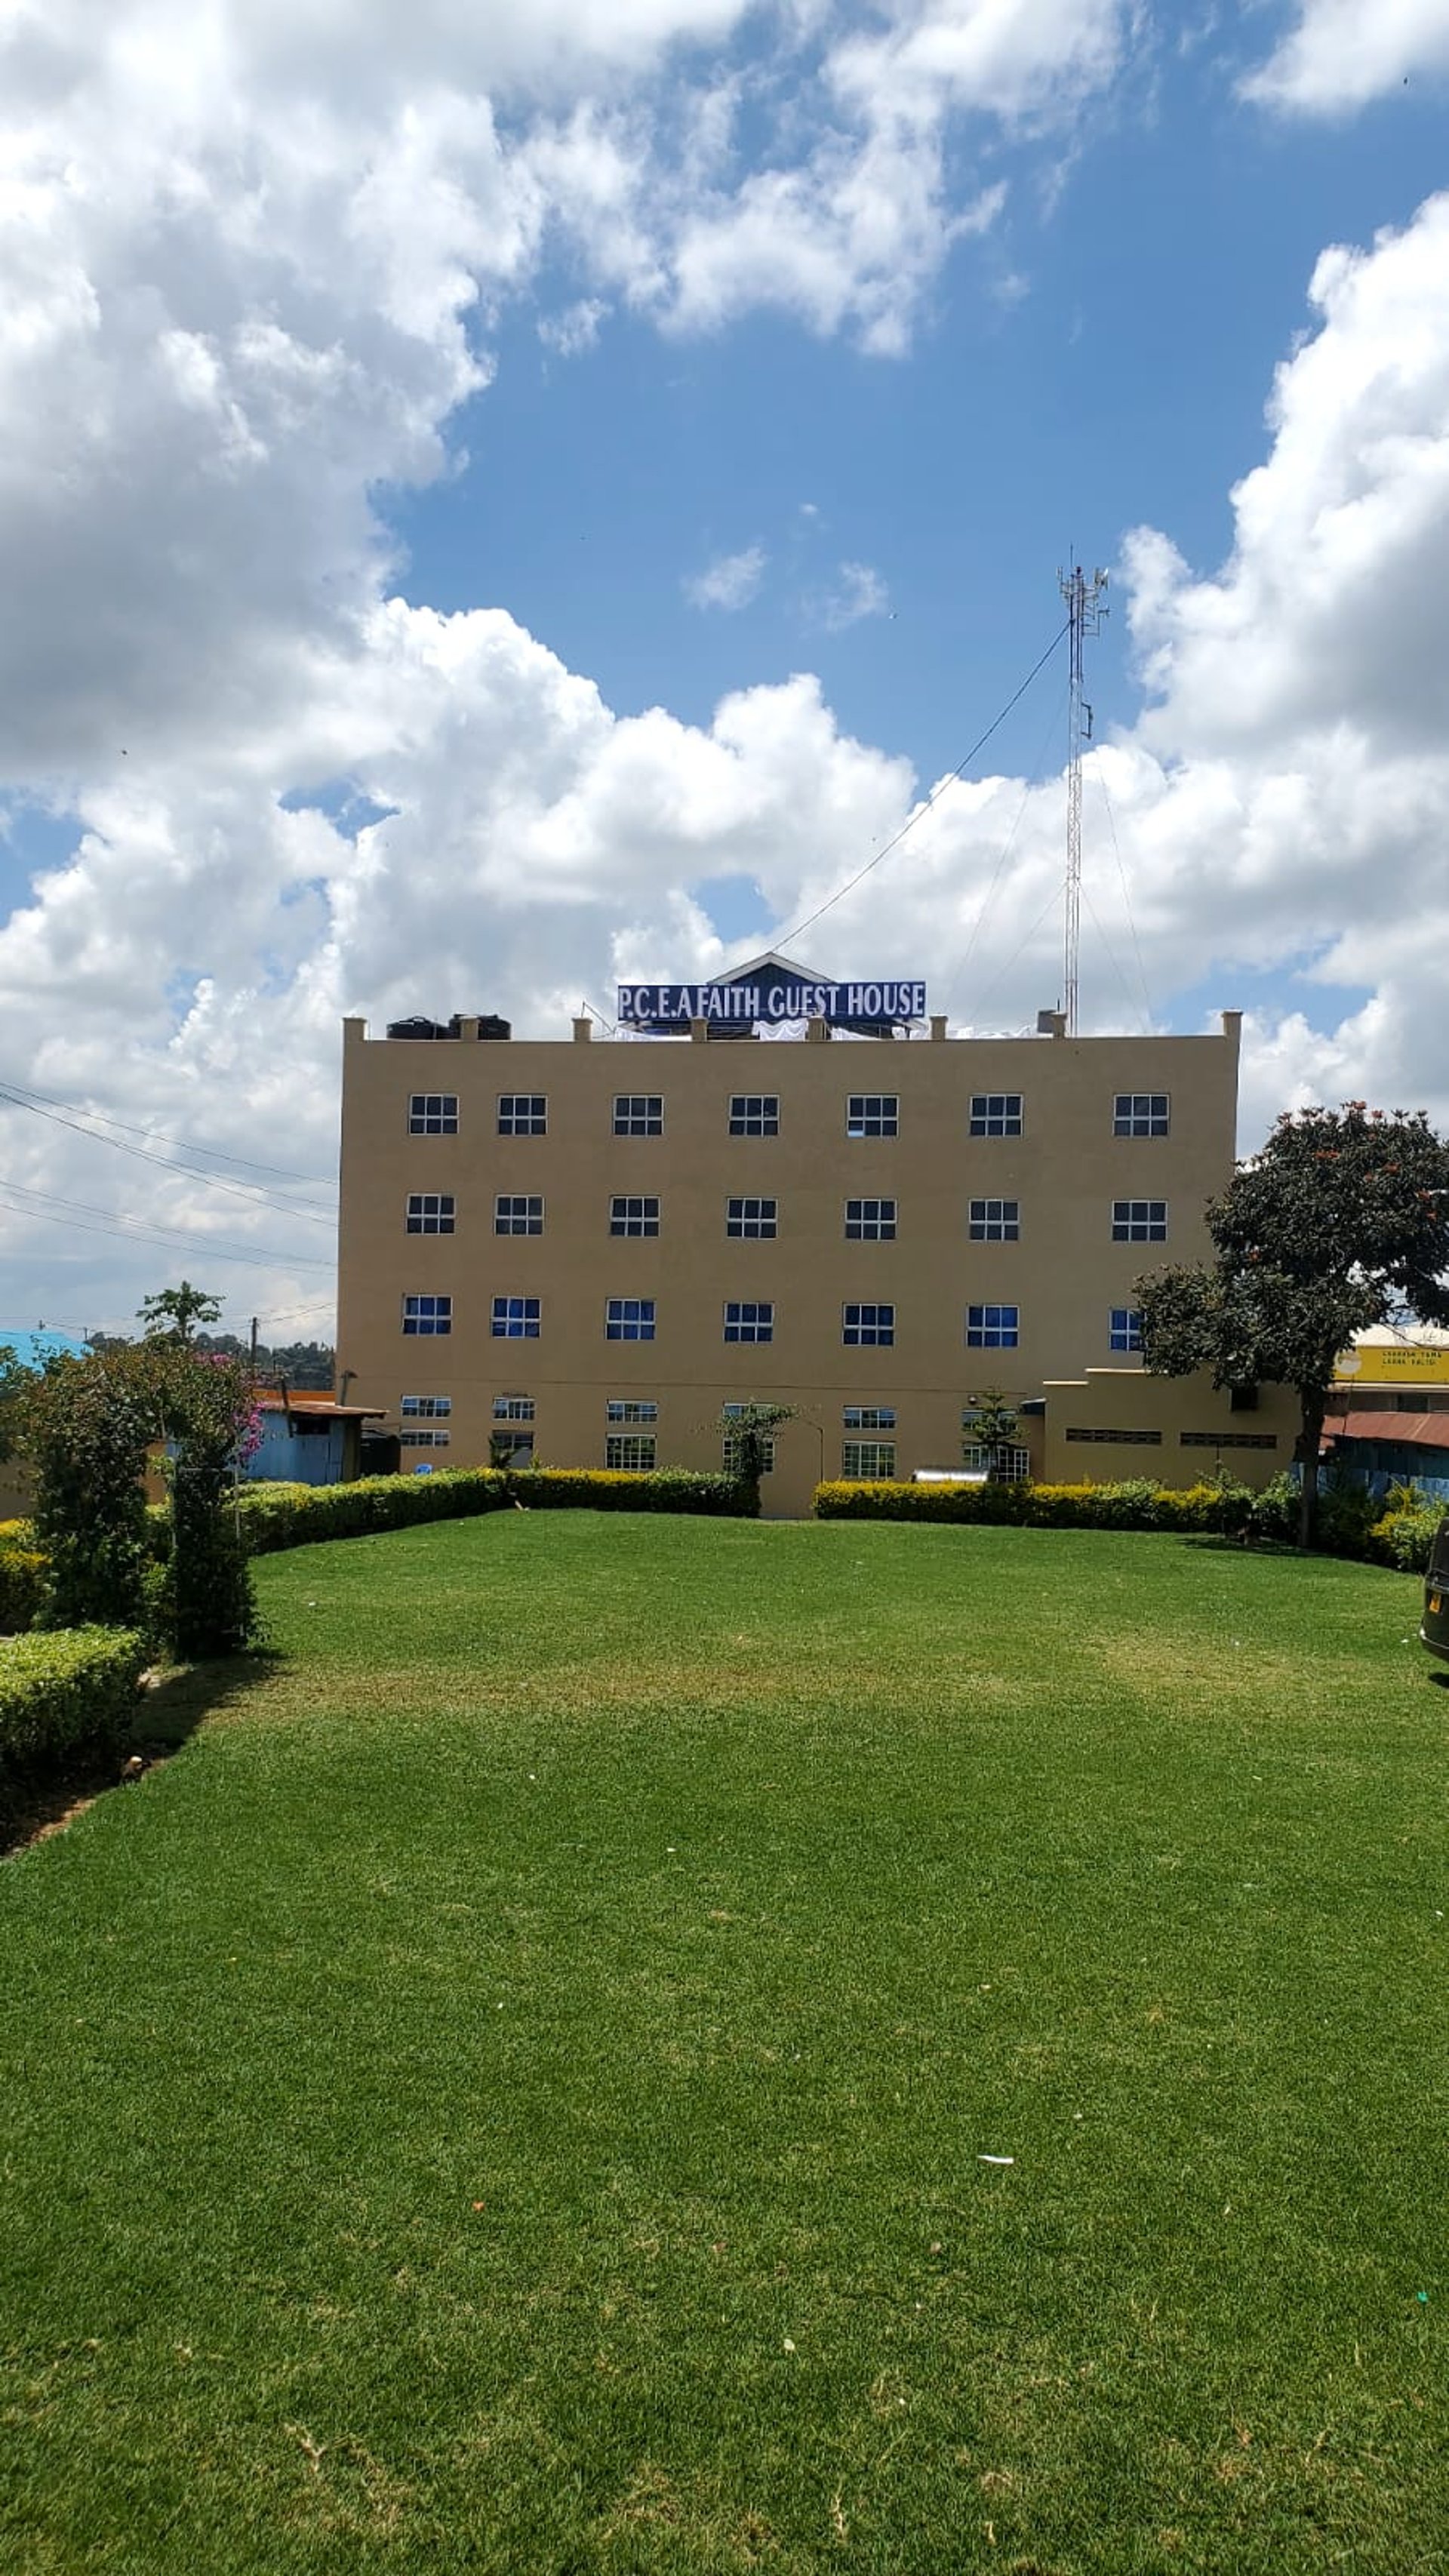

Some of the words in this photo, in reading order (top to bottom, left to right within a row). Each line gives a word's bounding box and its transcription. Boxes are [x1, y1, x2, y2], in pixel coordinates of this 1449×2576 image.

[619, 987, 692, 1018] P.C.E.A
[697, 986, 759, 1017] FAITH
[768, 985, 839, 1017] GUEST
[848, 983, 924, 1016] HOUSE
